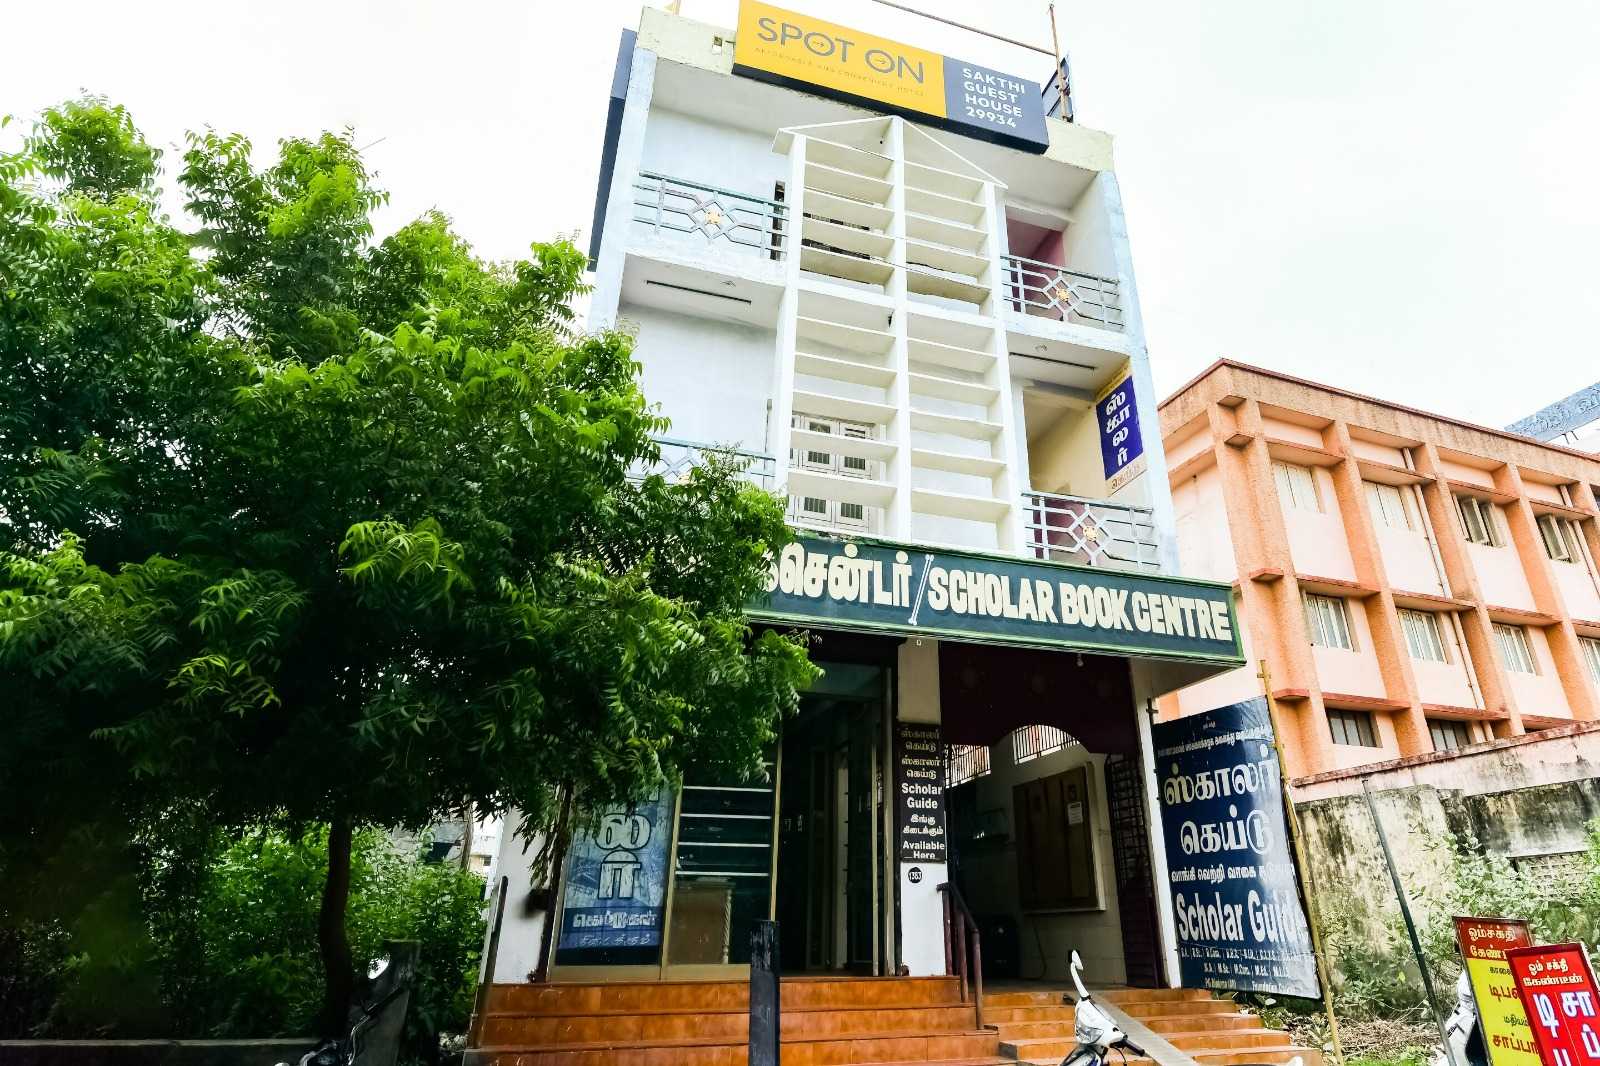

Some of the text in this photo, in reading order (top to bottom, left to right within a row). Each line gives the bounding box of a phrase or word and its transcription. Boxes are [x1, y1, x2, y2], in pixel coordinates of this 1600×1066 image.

[758, 17, 855, 63] SPOT
[864, 49, 925, 84] ON
[962, 68, 1025, 94] SAKTHI
[964, 81, 1018, 103] GUEST
[965, 93, 1023, 118] HOUSE
[965, 106, 1017, 128] 29934
[927, 567, 1233, 642] SCHOLAR BOOK CENTRE
[1164, 743, 1277, 806] ஸ்காலர்
[901, 782, 942, 795] Scholar
[906, 796, 938, 809] Guide
[1180, 804, 1274, 856] கெய்டு
[902, 840, 945, 850] Available
[913, 850, 936, 859] Here
[1176, 891, 1244, 942] Scholar
[1469, 943, 1508, 961] கேண்
